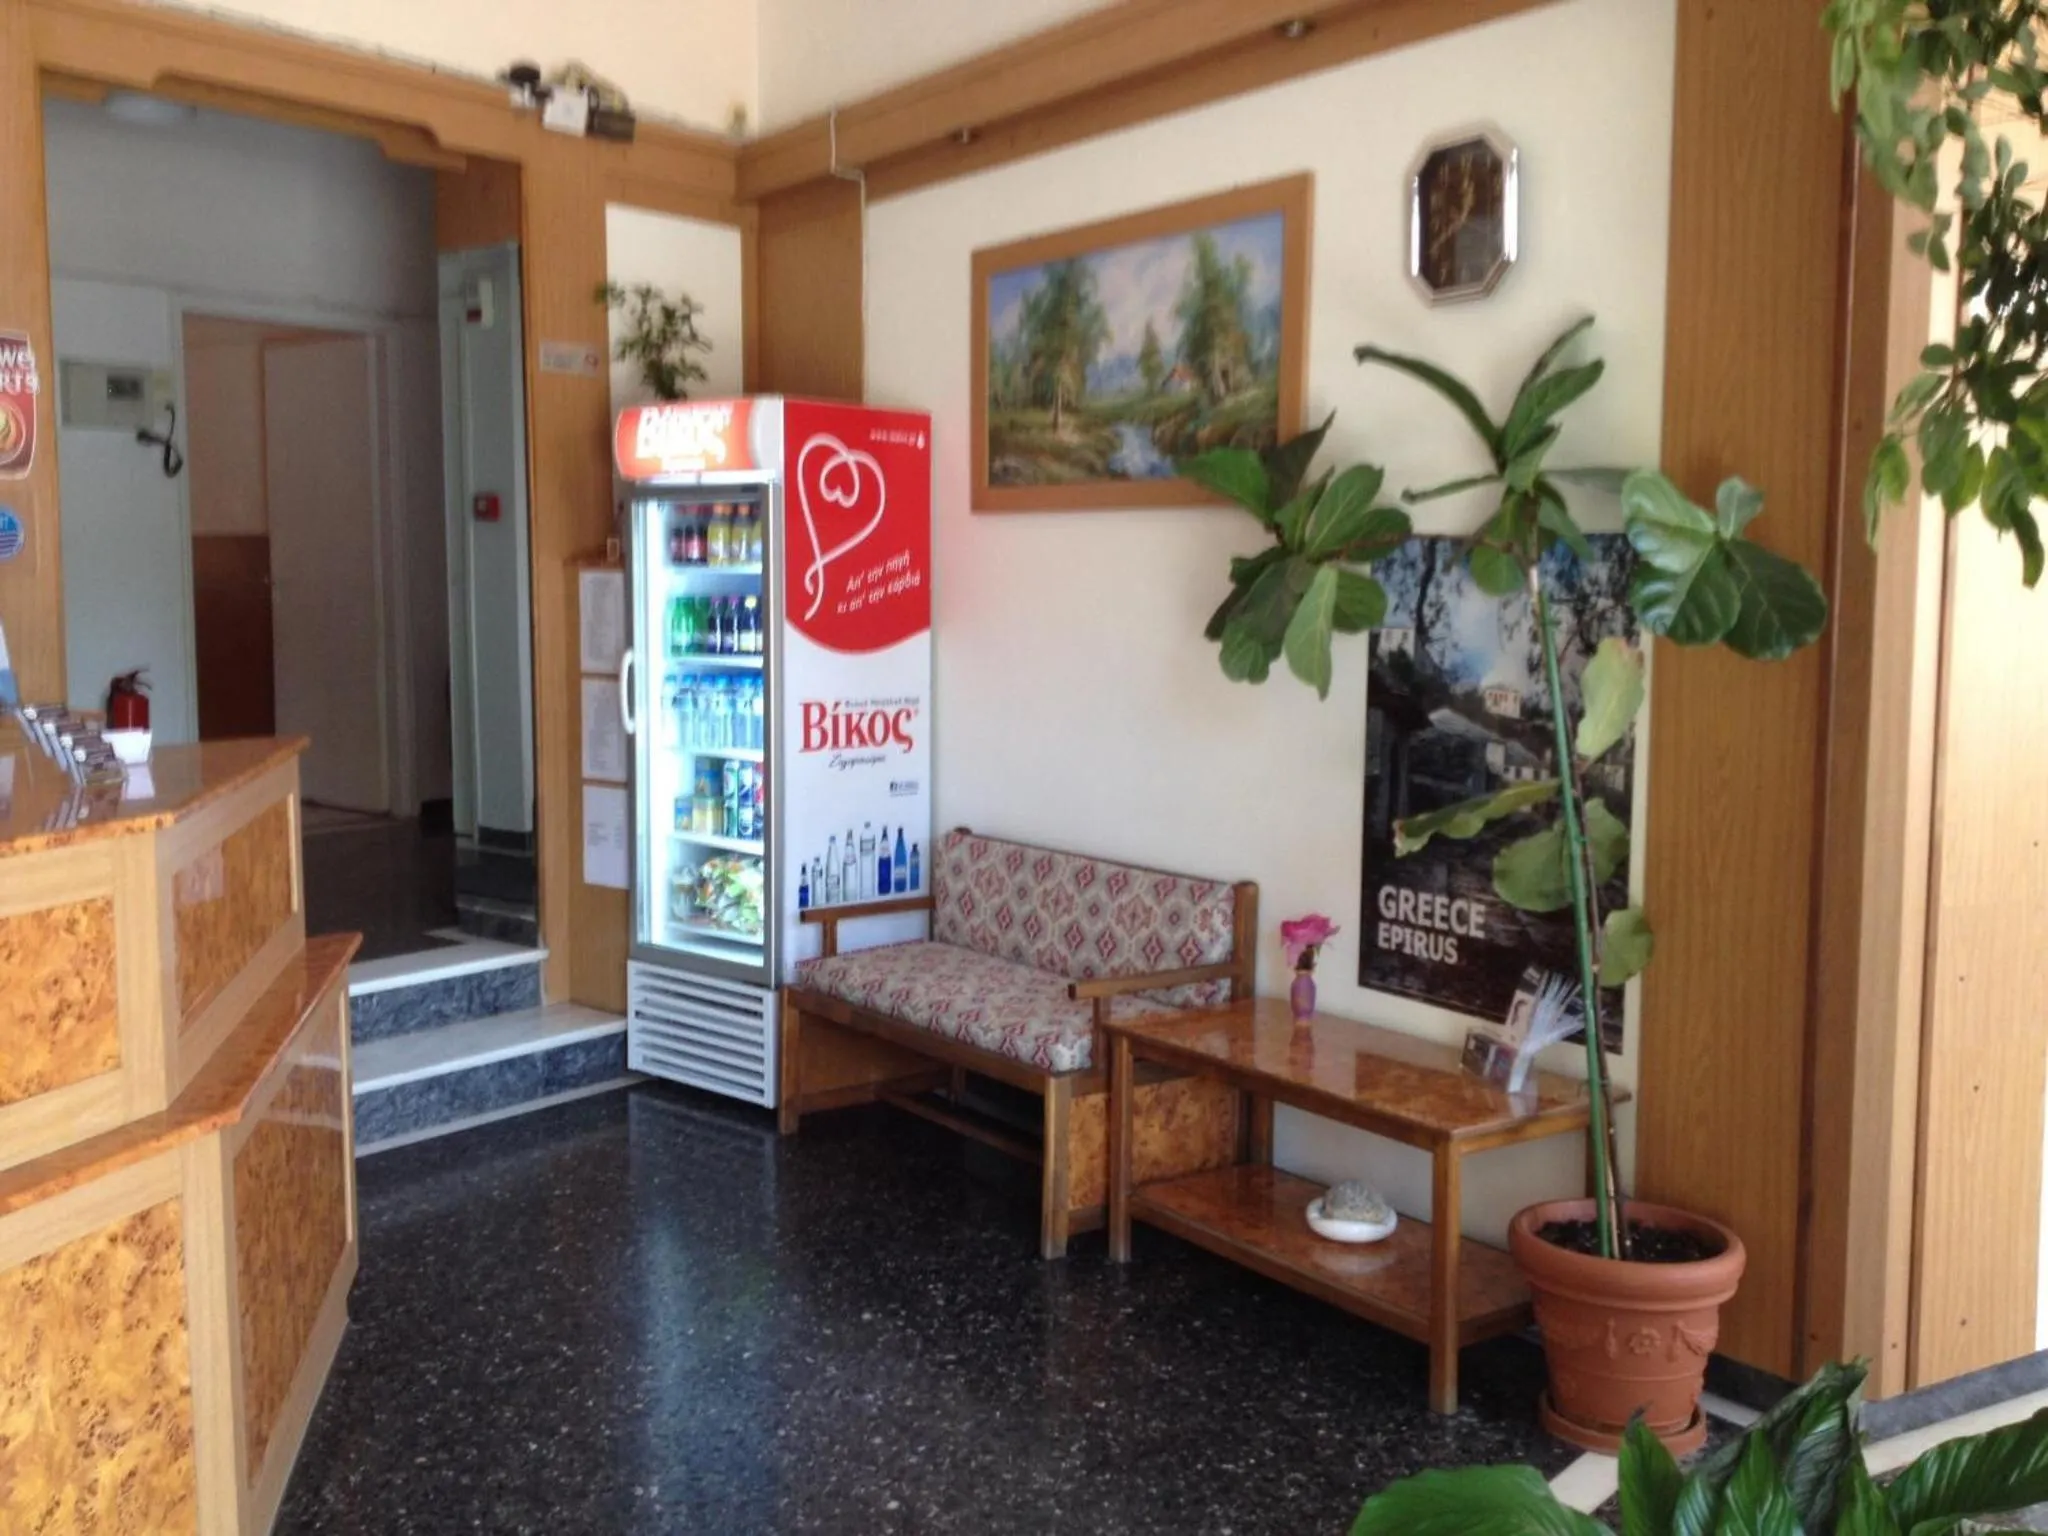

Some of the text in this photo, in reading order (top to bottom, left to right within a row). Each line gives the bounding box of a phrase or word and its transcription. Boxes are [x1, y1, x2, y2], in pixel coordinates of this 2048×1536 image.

[799, 701, 914, 754] Βίκος
[1378, 884, 1486, 939] GREECE
[1378, 921, 1459, 965] EPIRUS
